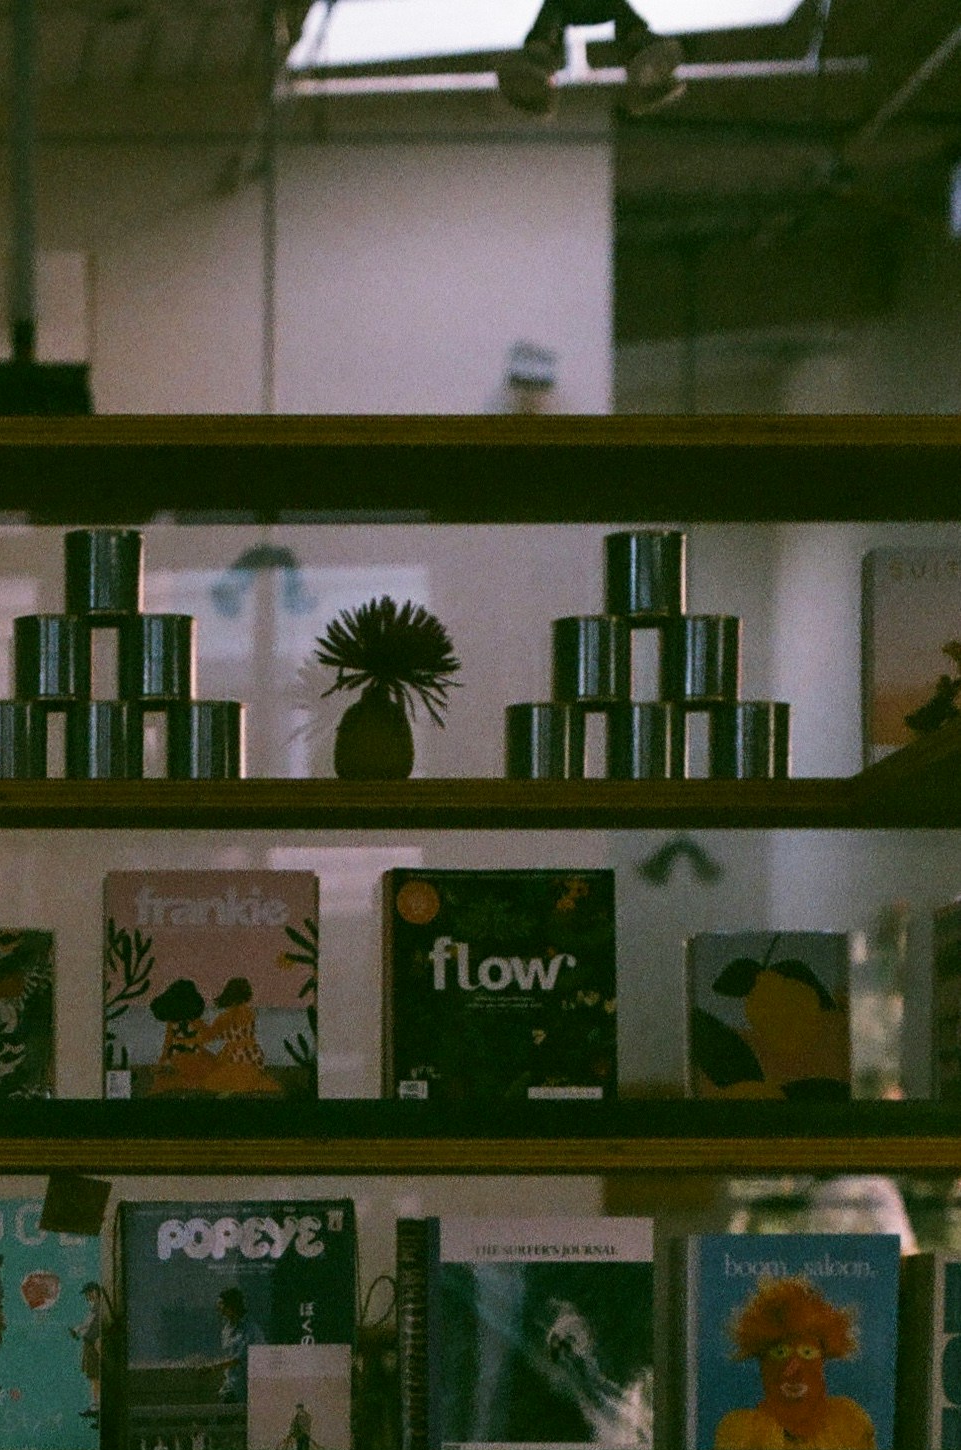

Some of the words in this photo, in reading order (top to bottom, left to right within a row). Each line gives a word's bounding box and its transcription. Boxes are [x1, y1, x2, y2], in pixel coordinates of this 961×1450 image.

[135, 886, 288, 926] frankie
[428, 934, 577, 991] flow
[157, 1215, 325, 1260] POPEYE
